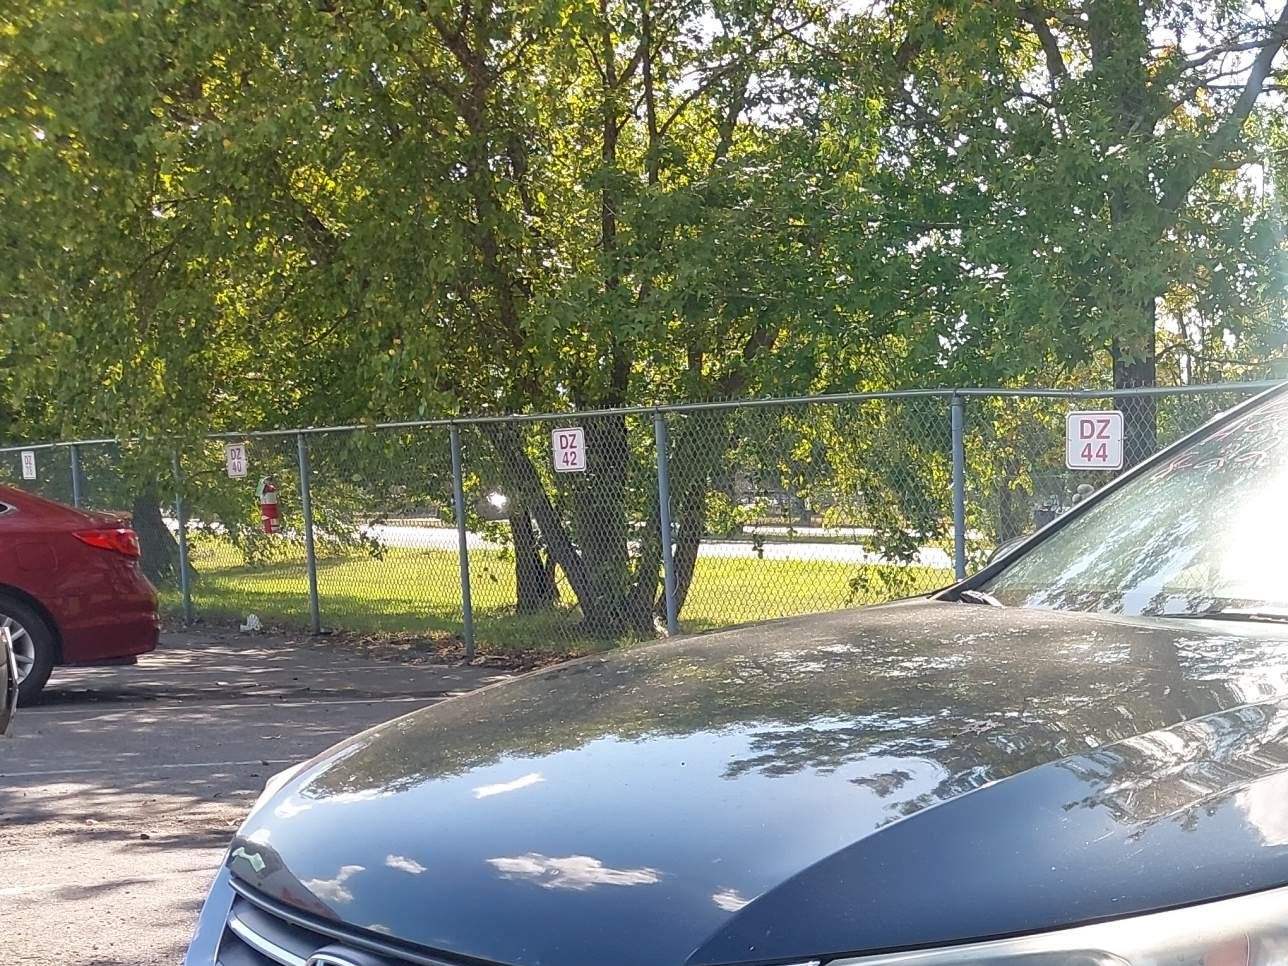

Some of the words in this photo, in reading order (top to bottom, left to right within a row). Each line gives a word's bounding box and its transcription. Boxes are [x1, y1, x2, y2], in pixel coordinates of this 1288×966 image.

[1079, 419, 1111, 440] DZ
[560, 434, 577, 449] DZ
[230, 448, 242, 460] DZ
[562, 451, 577, 466] 42
[1080, 443, 1109, 462] 44
[232, 461, 242, 472] 40
